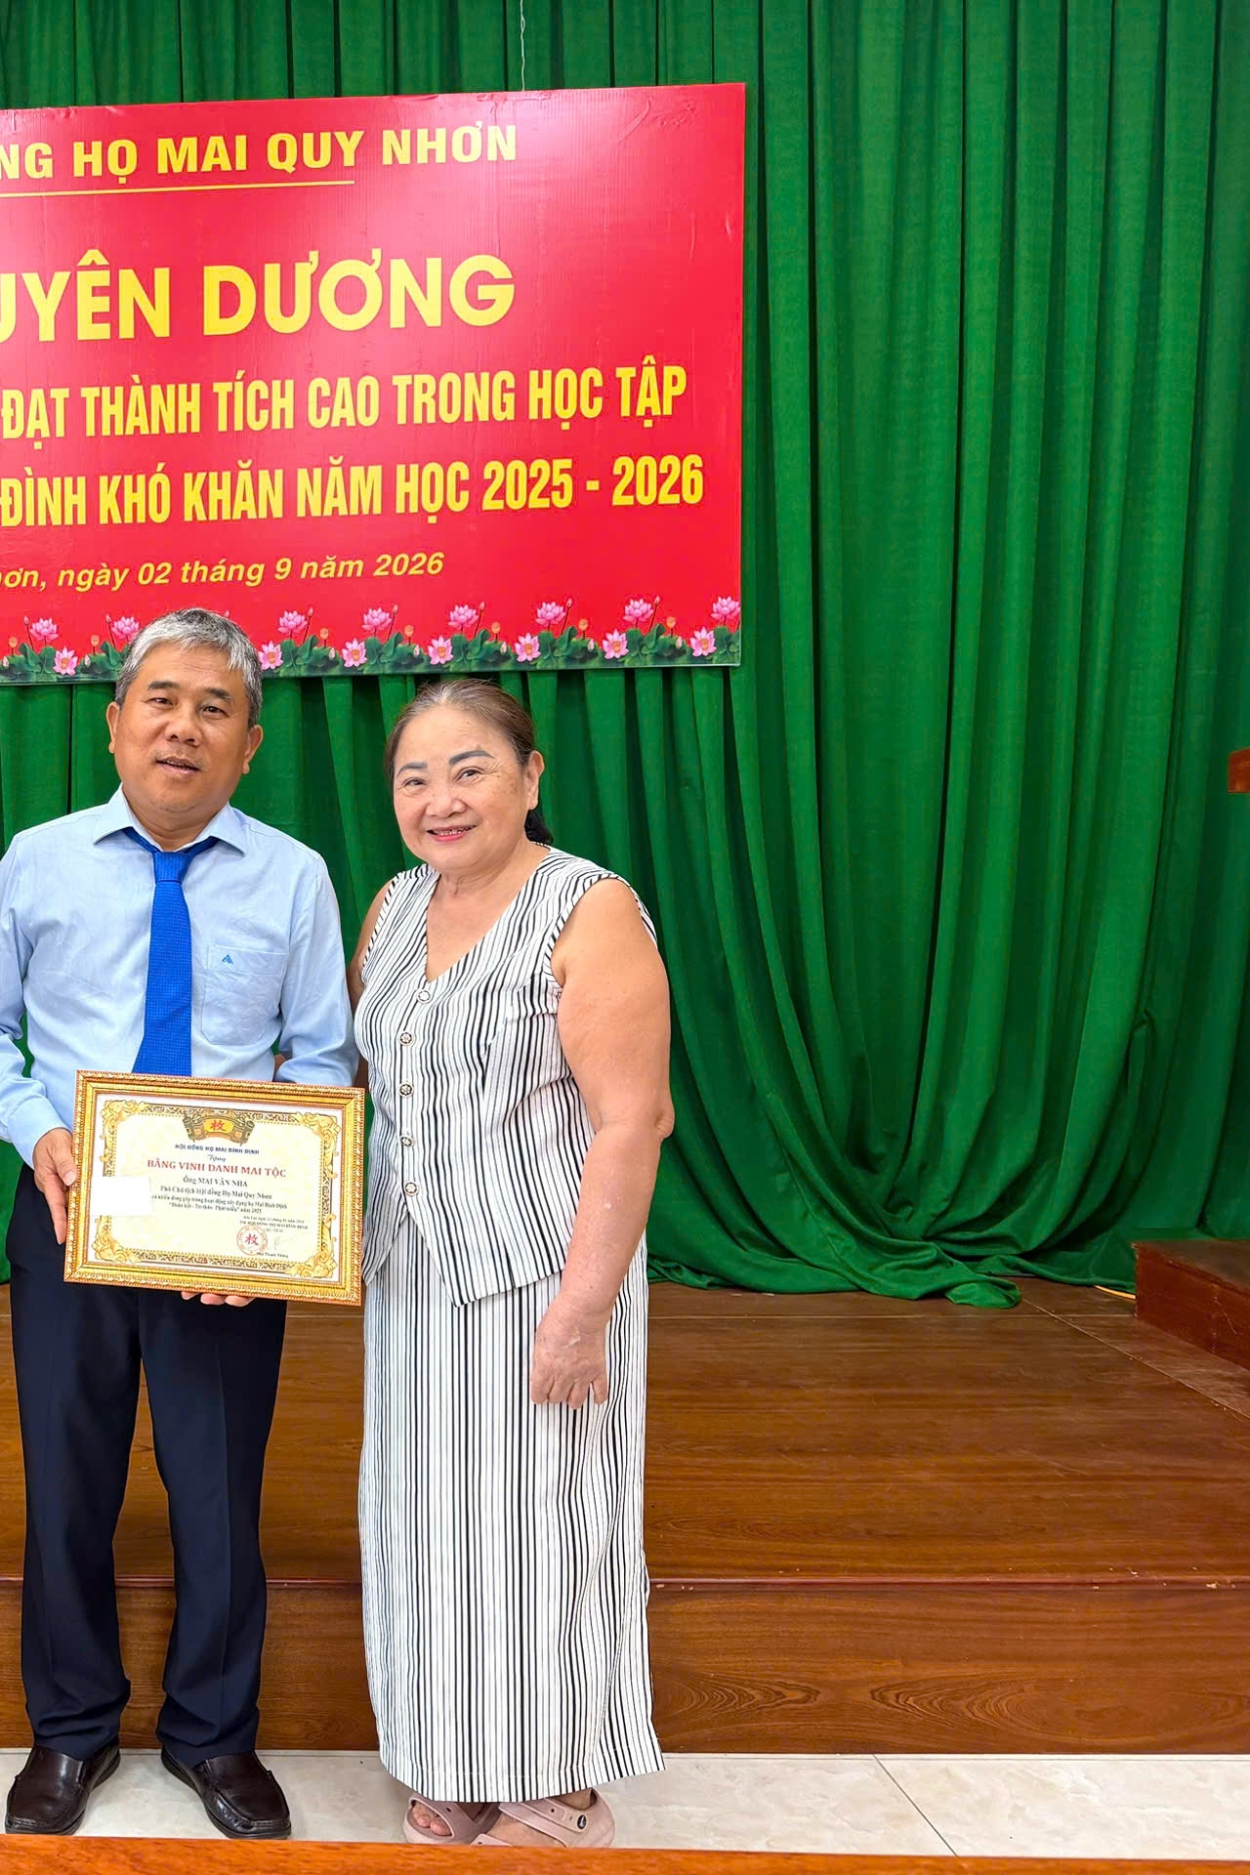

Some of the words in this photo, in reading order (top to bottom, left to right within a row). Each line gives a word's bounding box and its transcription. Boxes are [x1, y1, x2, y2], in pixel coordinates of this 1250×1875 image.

[73, 140, 138, 186] HỌ
[157, 134, 248, 174] MAI
[267, 130, 364, 174] QUY
[382, 125, 518, 166] NHƠN
[203, 249, 516, 336] DƯƠNG
[0, 387, 71, 450] ĐẠT
[80, 374, 201, 438] THÀNH
[212, 369, 295, 432] TÍCH
[307, 375, 380, 429] CAO
[391, 370, 516, 425] TRONG
[528, 367, 603, 431] HỌC
[615, 355, 687, 428] TẬP
[99, 462, 171, 525] KHÓ
[183, 459, 284, 522] KHĂN
[296, 455, 383, 518] NĂM
[395, 460, 470, 524] HỌC
[482, 458, 573, 511] 2025
[586, 480, 600, 491] -
[612, 454, 704, 506] 2026
[57, 568, 129, 594] ngày
[138, 562, 172, 585] 02
[181, 559, 265, 587] tháng
[274, 557, 292, 580] 9
[300, 557, 364, 579] năm
[373, 552, 445, 577] 2026
[179, 1161, 205, 1172] VINH
[208, 1164, 238, 1174] DANH
[241, 1166, 262, 1176] MAI
[264, 1167, 287, 1178] TỘC
[183, 1175, 197, 1185] Ông
[198, 1177, 213, 1185] MAI
[243, 1191, 255, 1199] Quy
